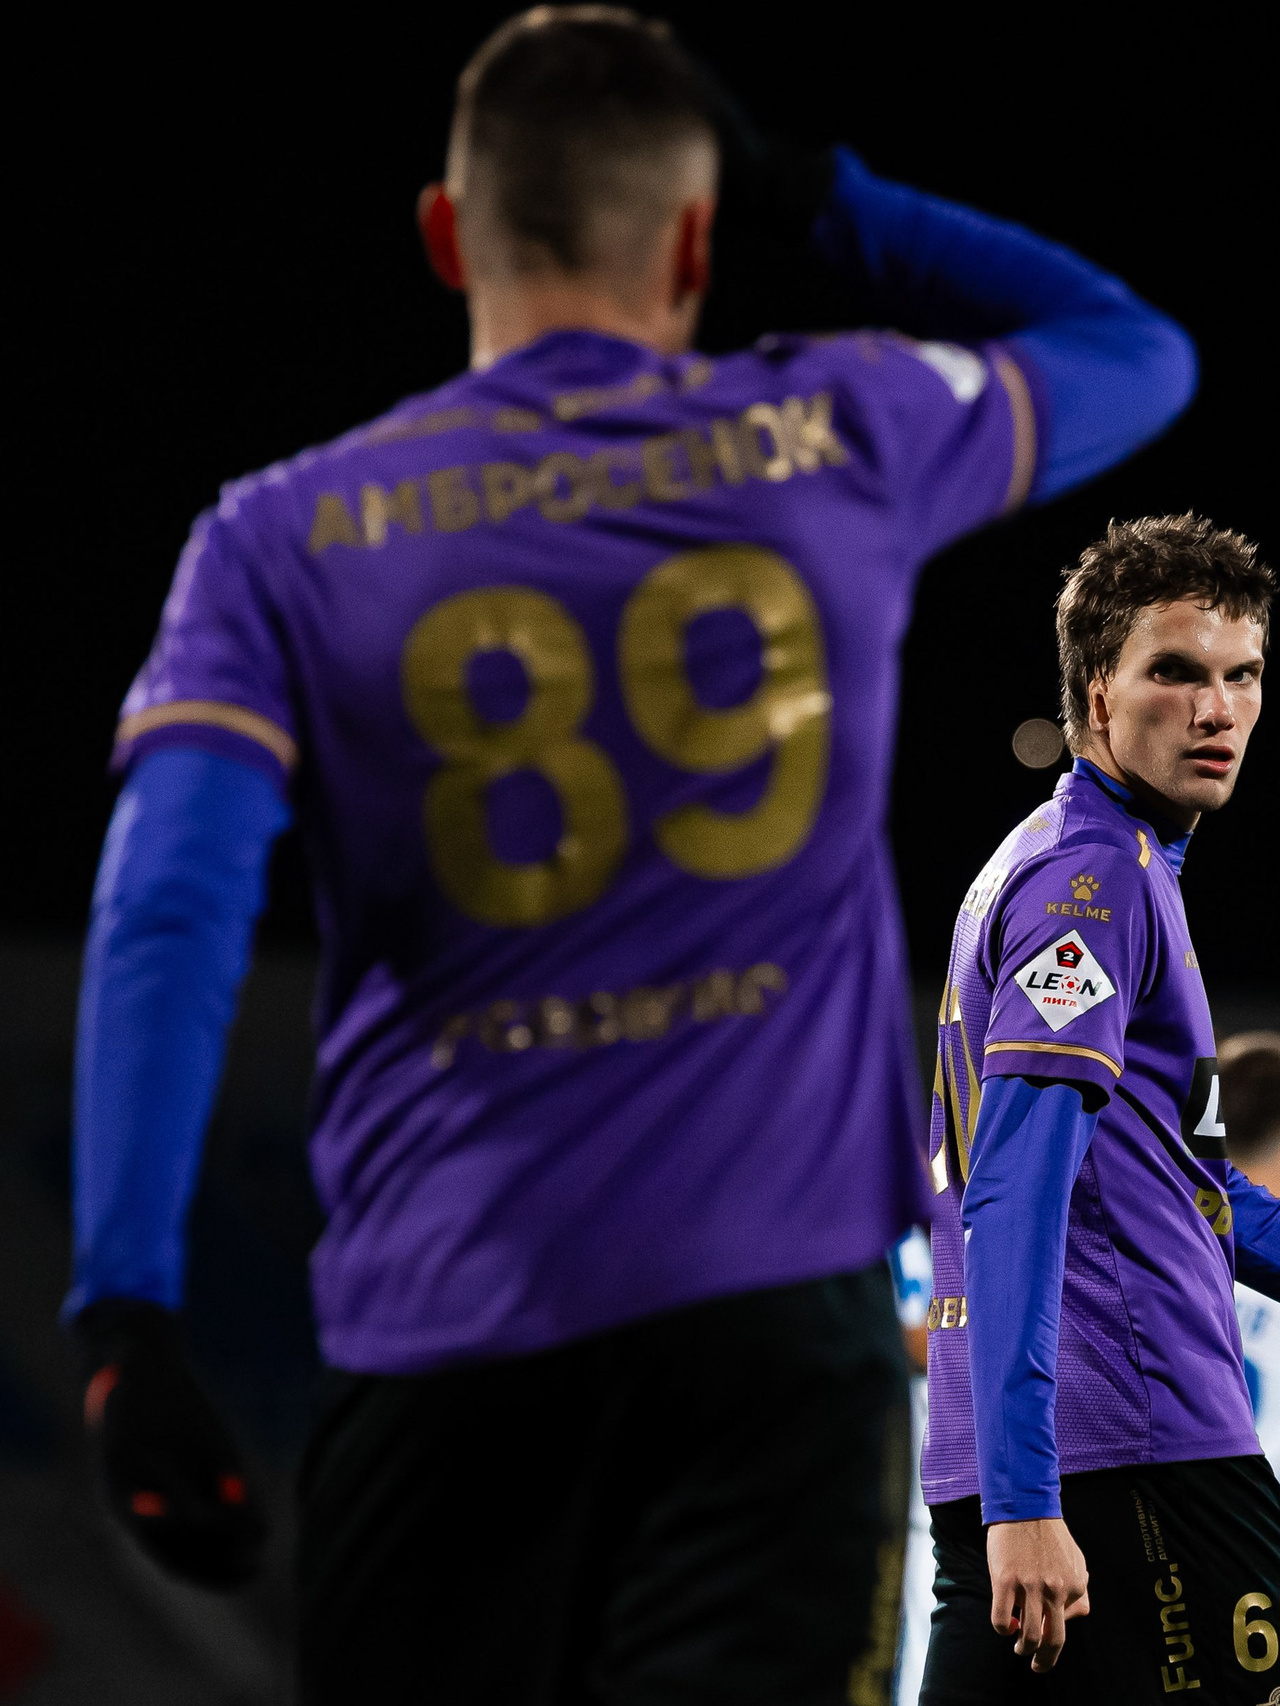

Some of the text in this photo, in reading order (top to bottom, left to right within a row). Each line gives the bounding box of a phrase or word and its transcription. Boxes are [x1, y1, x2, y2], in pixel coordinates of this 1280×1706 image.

[308, 393, 848, 556] АМБРОСЕНОК
[403, 541, 833, 930] 89
[1046, 902, 1112, 922] KELME
[1026, 970, 1103, 997] LEON
[1062, 951, 1075, 962] 2
[1154, 1563, 1201, 1693] Func.
